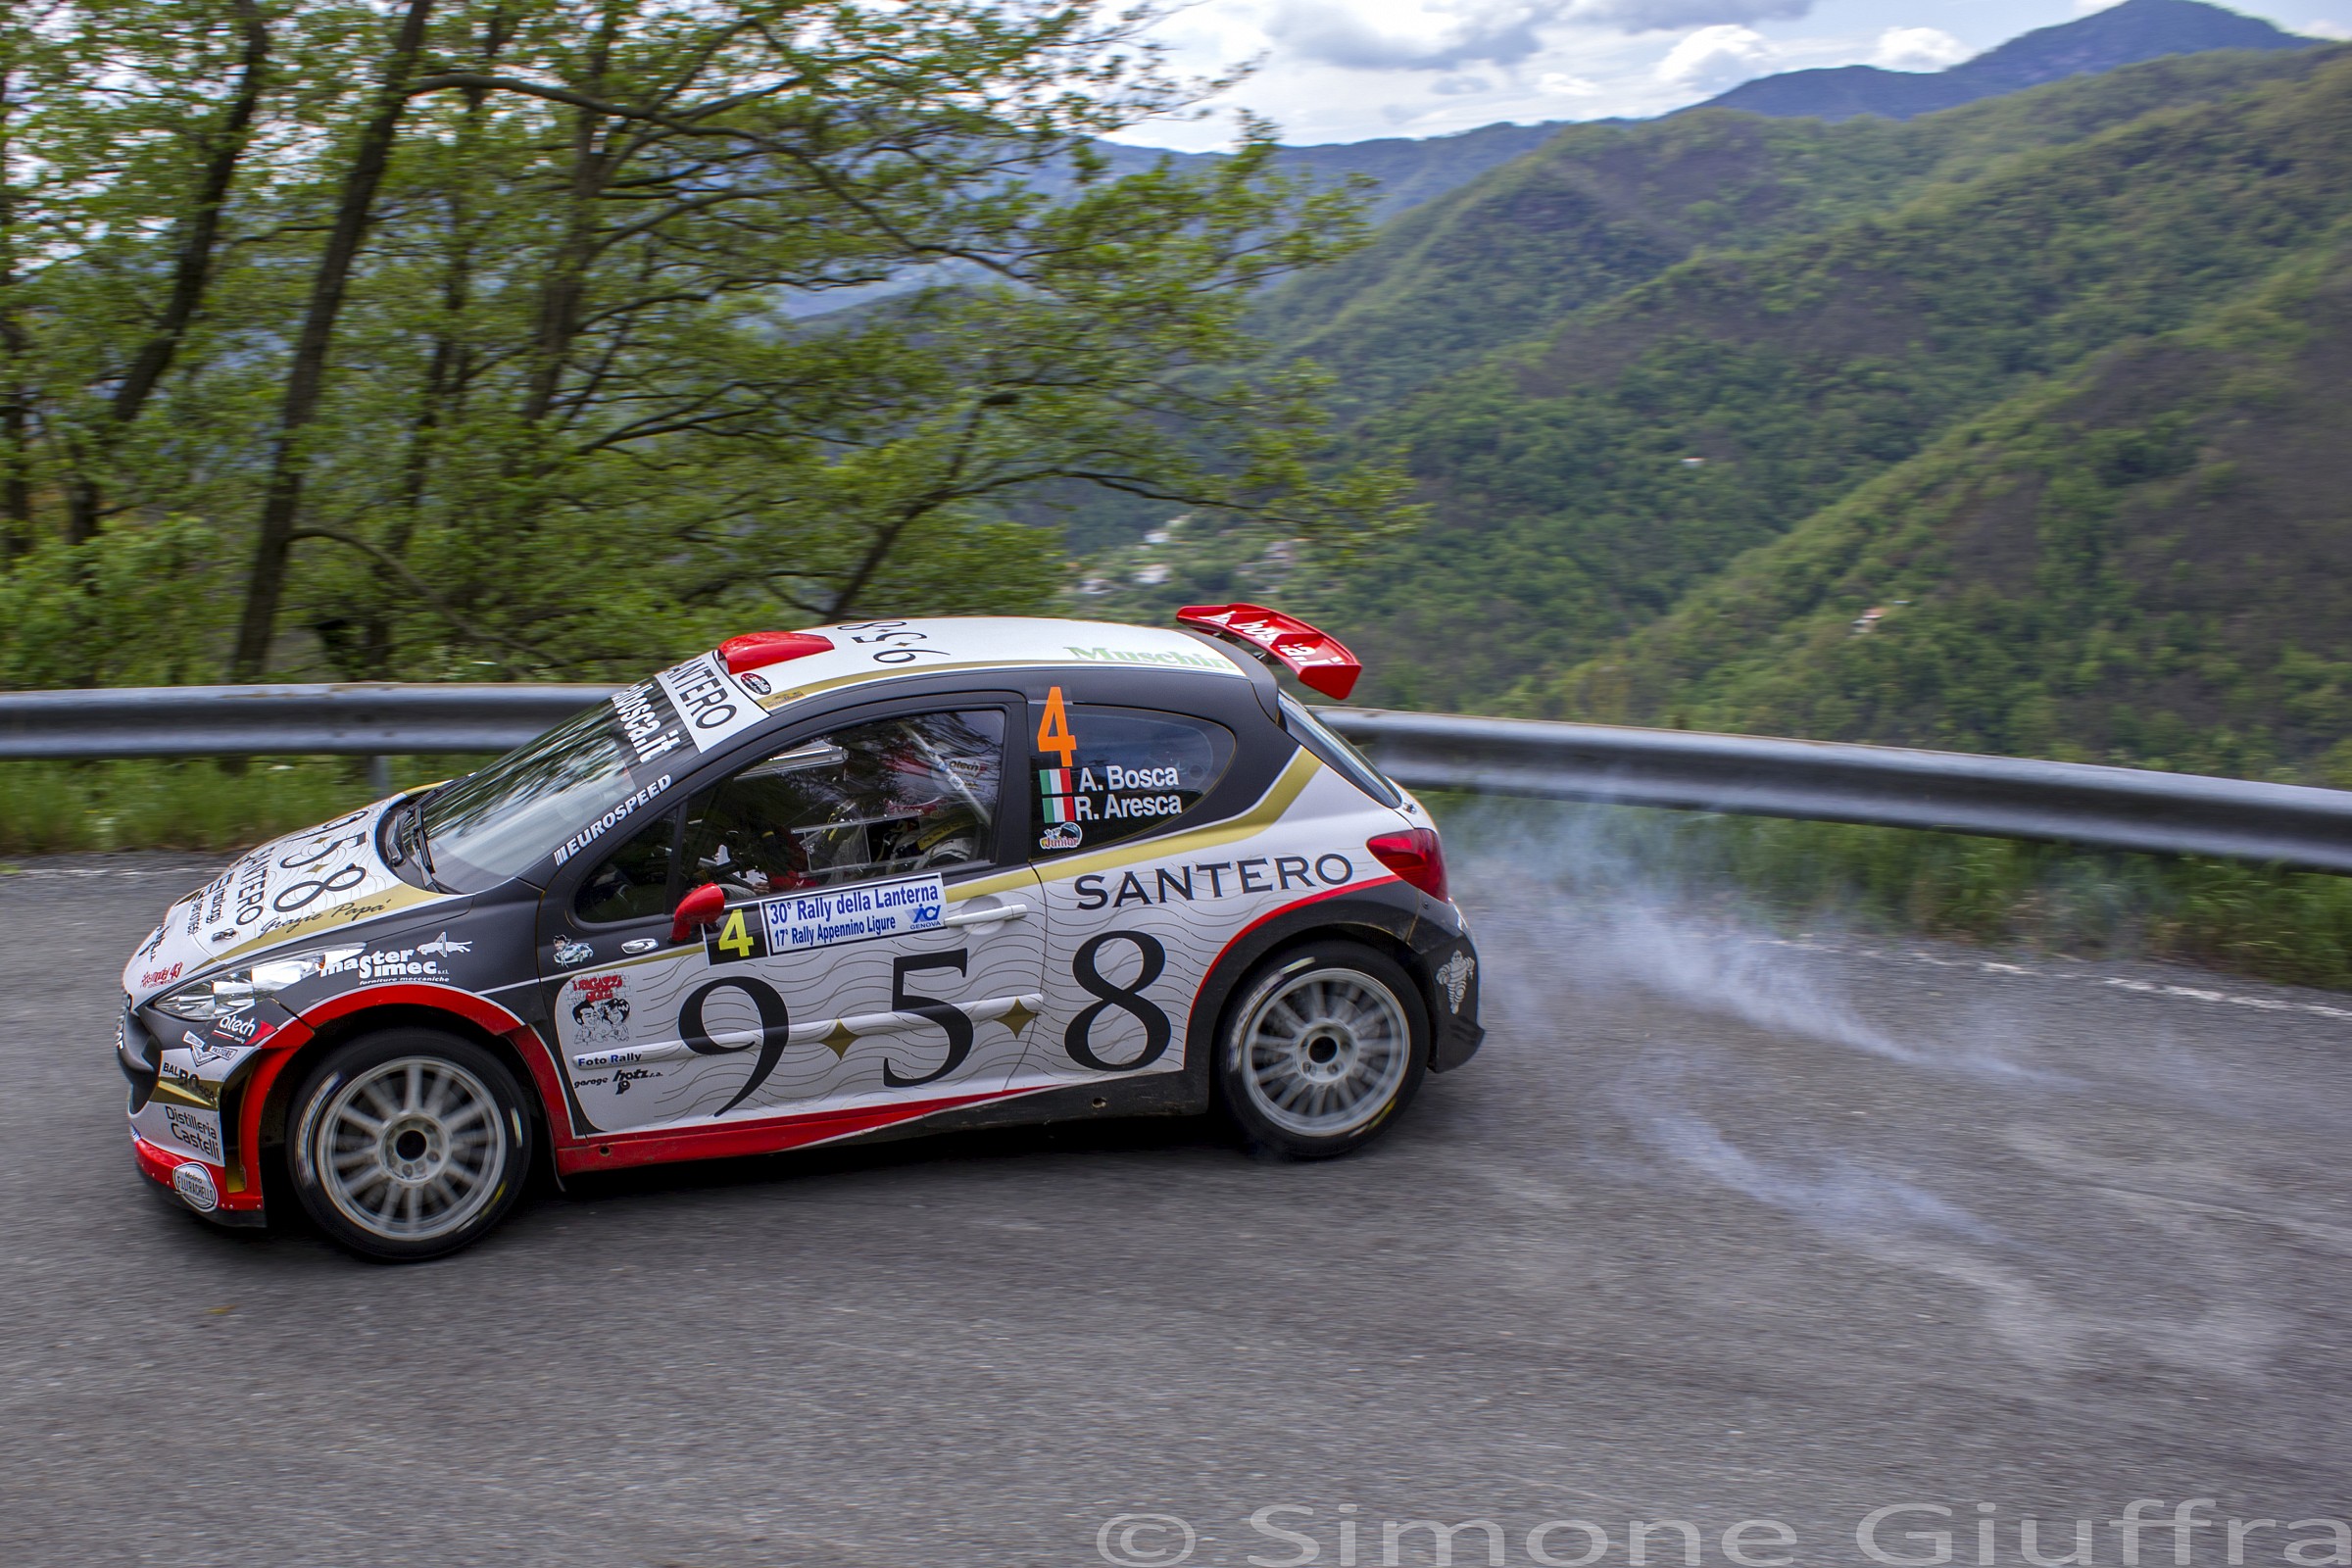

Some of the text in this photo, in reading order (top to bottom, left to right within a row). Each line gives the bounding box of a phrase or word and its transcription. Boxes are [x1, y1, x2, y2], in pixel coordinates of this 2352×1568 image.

[665, 657, 737, 729] ANTERO
[1037, 686, 1077, 767] 4
[1078, 764, 1180, 793] A. Bosca
[565, 774, 673, 858] EUROSPEED
[1073, 793, 1183, 821] R. Aresca
[1074, 853, 1353, 910] SANTERO
[797, 899, 833, 922] Rally
[836, 892, 871, 915] della
[874, 884, 939, 909] Lanterna
[717, 908, 755, 957] 4
[792, 925, 814, 947] Rally
[816, 920, 865, 944] Appennino
[866, 914, 896, 935] Ligure
[909, 921, 942, 930] GENOVA
[219, 1014, 256, 1038] atech
[677, 975, 790, 1118] 9
[882, 948, 975, 1089] 5
[1063, 930, 1172, 1072] 8
[211, 1048, 235, 1059] PASTORE
[577, 1052, 643, 1067] Foto Rally
[573, 1077, 609, 1089] garage
[165, 1105, 218, 1140] Distilleria
[171, 1122, 220, 1161] Castelli
